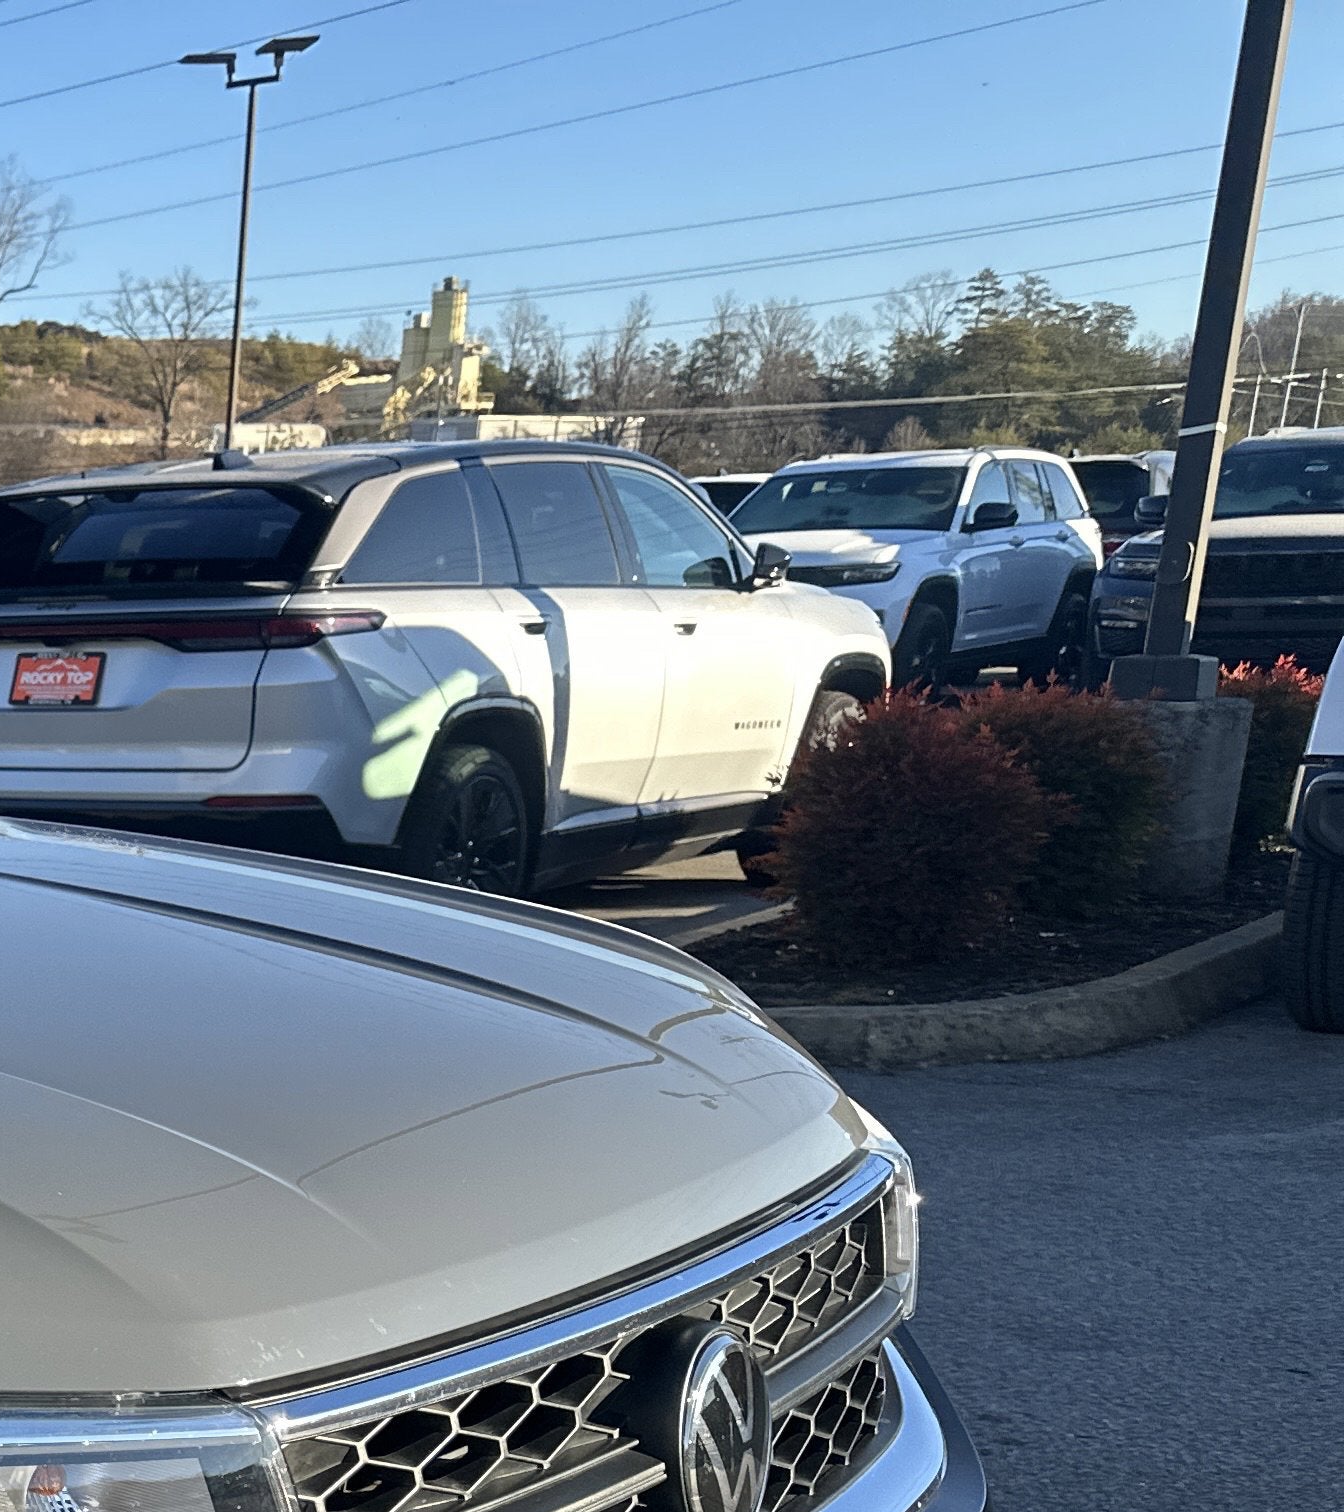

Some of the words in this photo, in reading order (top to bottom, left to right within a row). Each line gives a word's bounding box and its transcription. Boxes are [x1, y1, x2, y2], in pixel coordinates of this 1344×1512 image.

[20, 671, 65, 685] ROCKY
[66, 671, 94, 685] TOP
[734, 720, 782, 730] WAGONEER
